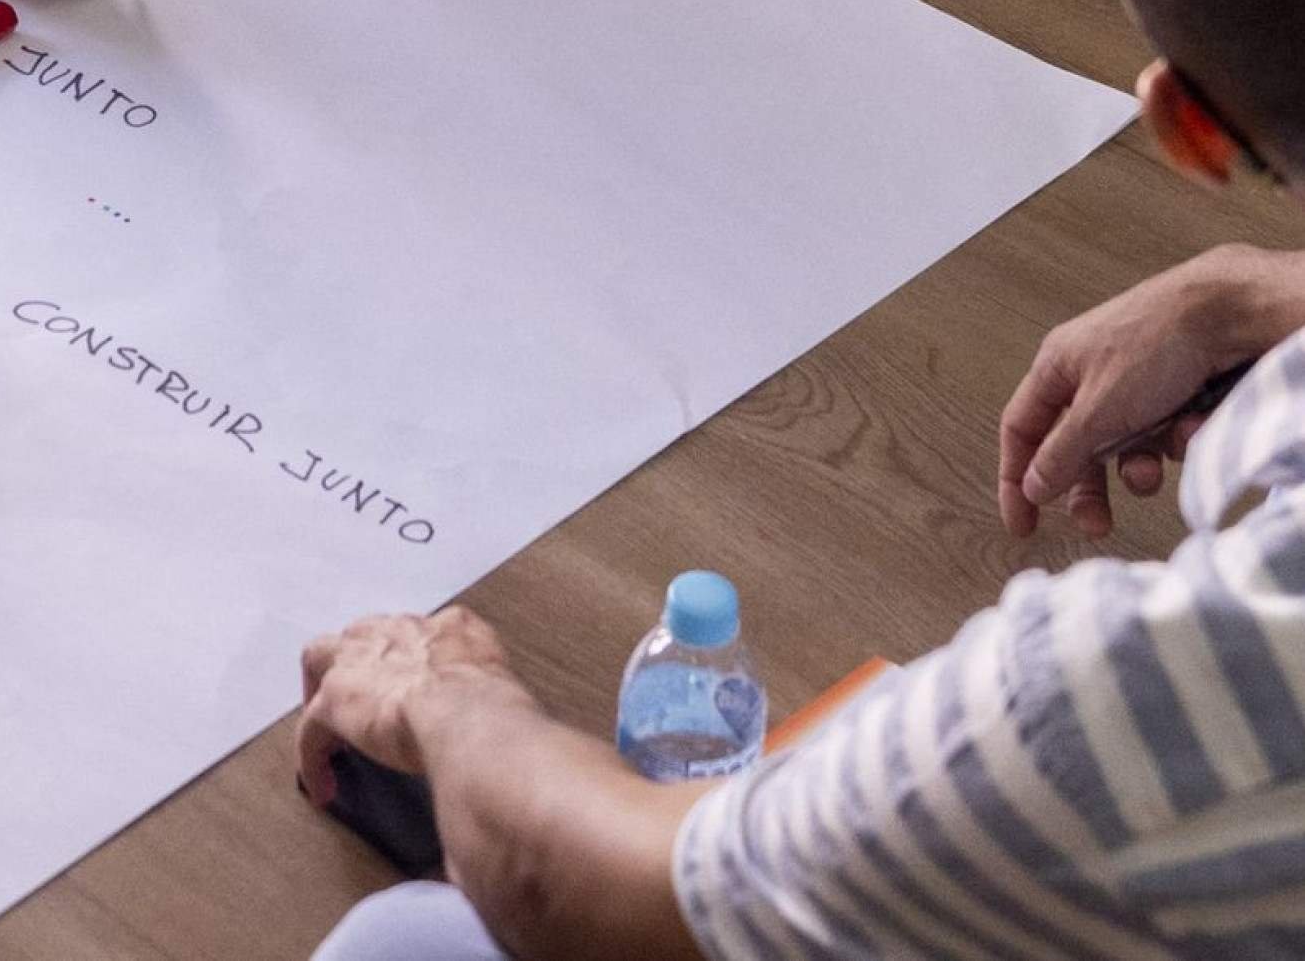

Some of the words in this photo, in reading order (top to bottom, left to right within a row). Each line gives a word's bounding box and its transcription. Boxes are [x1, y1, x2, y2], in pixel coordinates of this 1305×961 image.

[4, 45, 157, 128] JUNTO
[13, 300, 263, 452] CONSTRUIR
[280, 450, 435, 544] JUNTO
